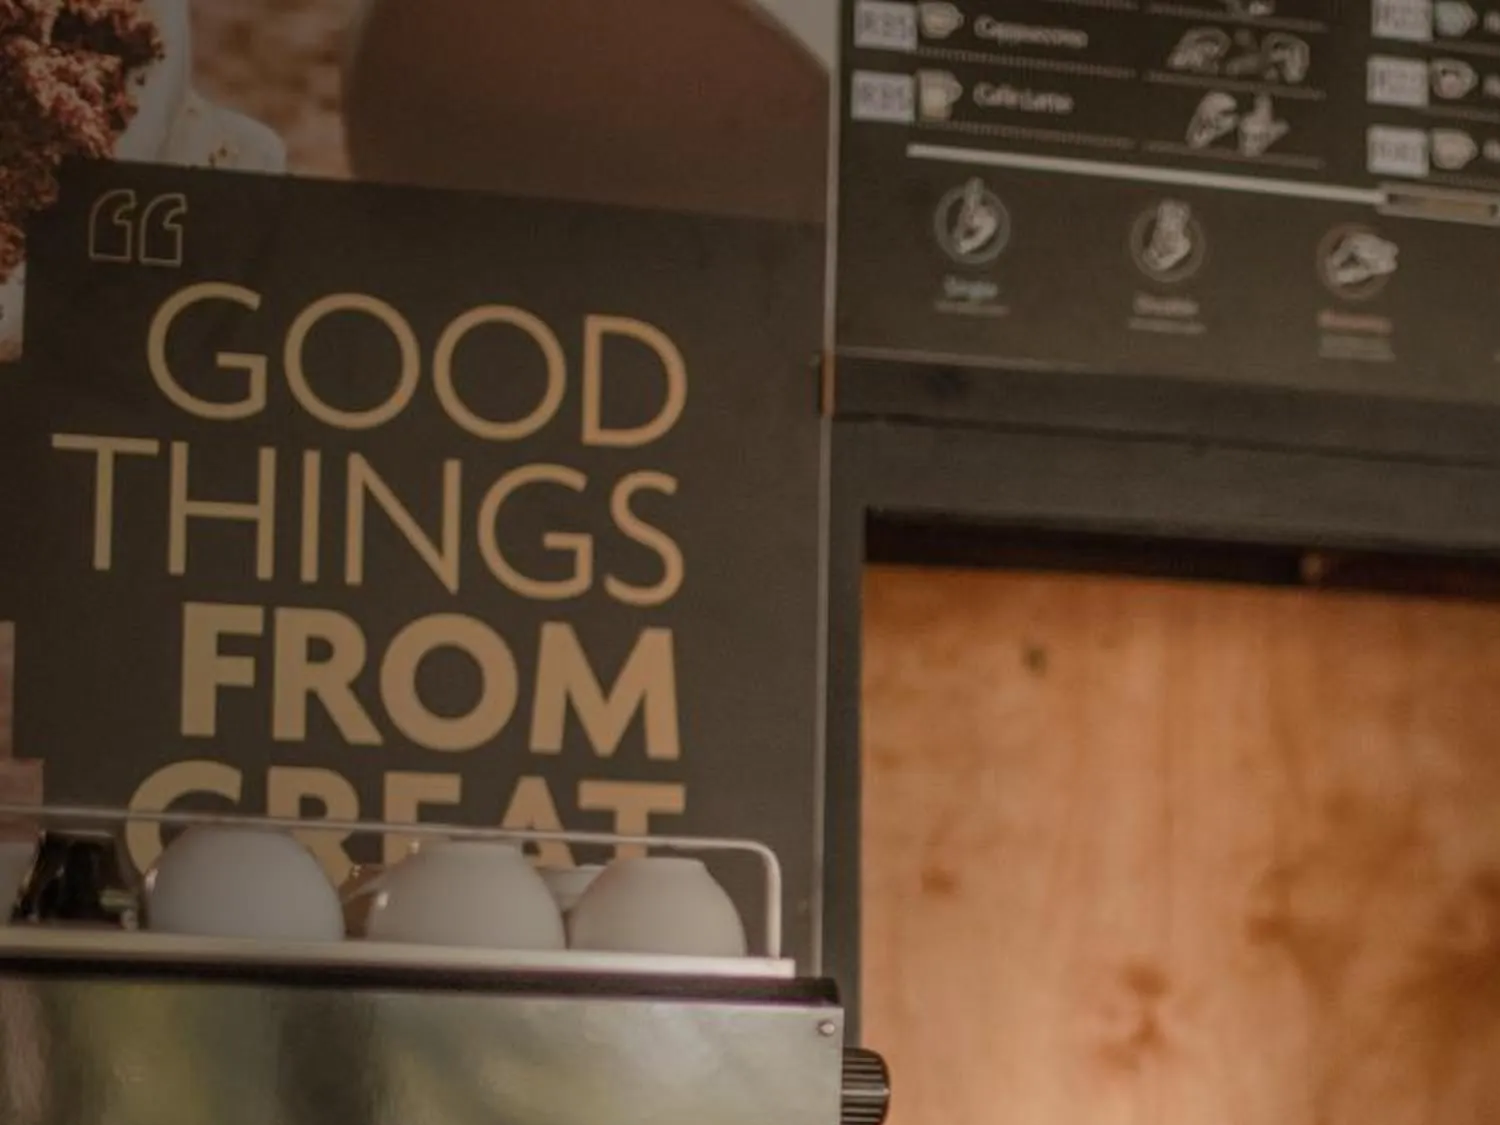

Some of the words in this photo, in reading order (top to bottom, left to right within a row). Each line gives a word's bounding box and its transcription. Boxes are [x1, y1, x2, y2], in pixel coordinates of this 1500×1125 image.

[147, 281, 688, 448] GOOD
[51, 432, 685, 607] THINGS
[180, 601, 682, 760] FROM
